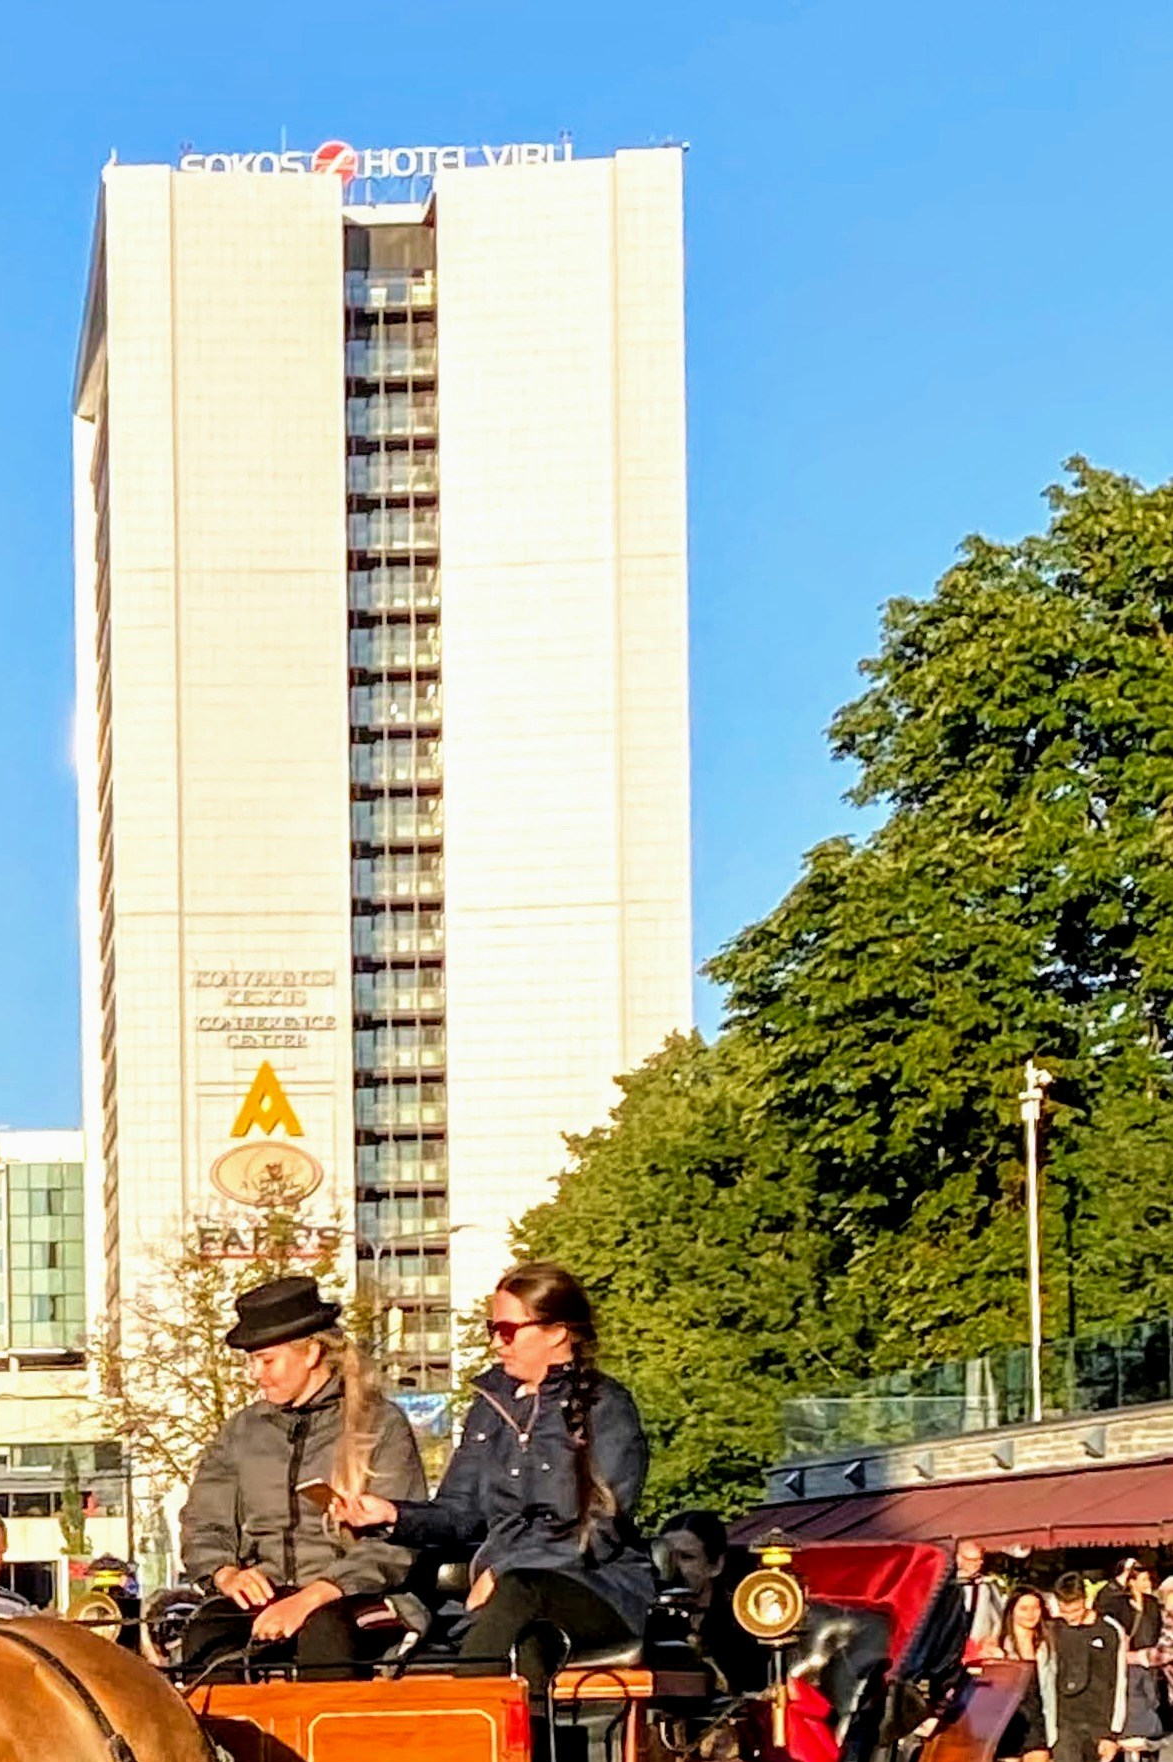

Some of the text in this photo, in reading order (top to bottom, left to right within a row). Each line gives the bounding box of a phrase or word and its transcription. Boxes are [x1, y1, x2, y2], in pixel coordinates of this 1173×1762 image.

[180, 143, 573, 178] SOKOS HOTEL VIRU
